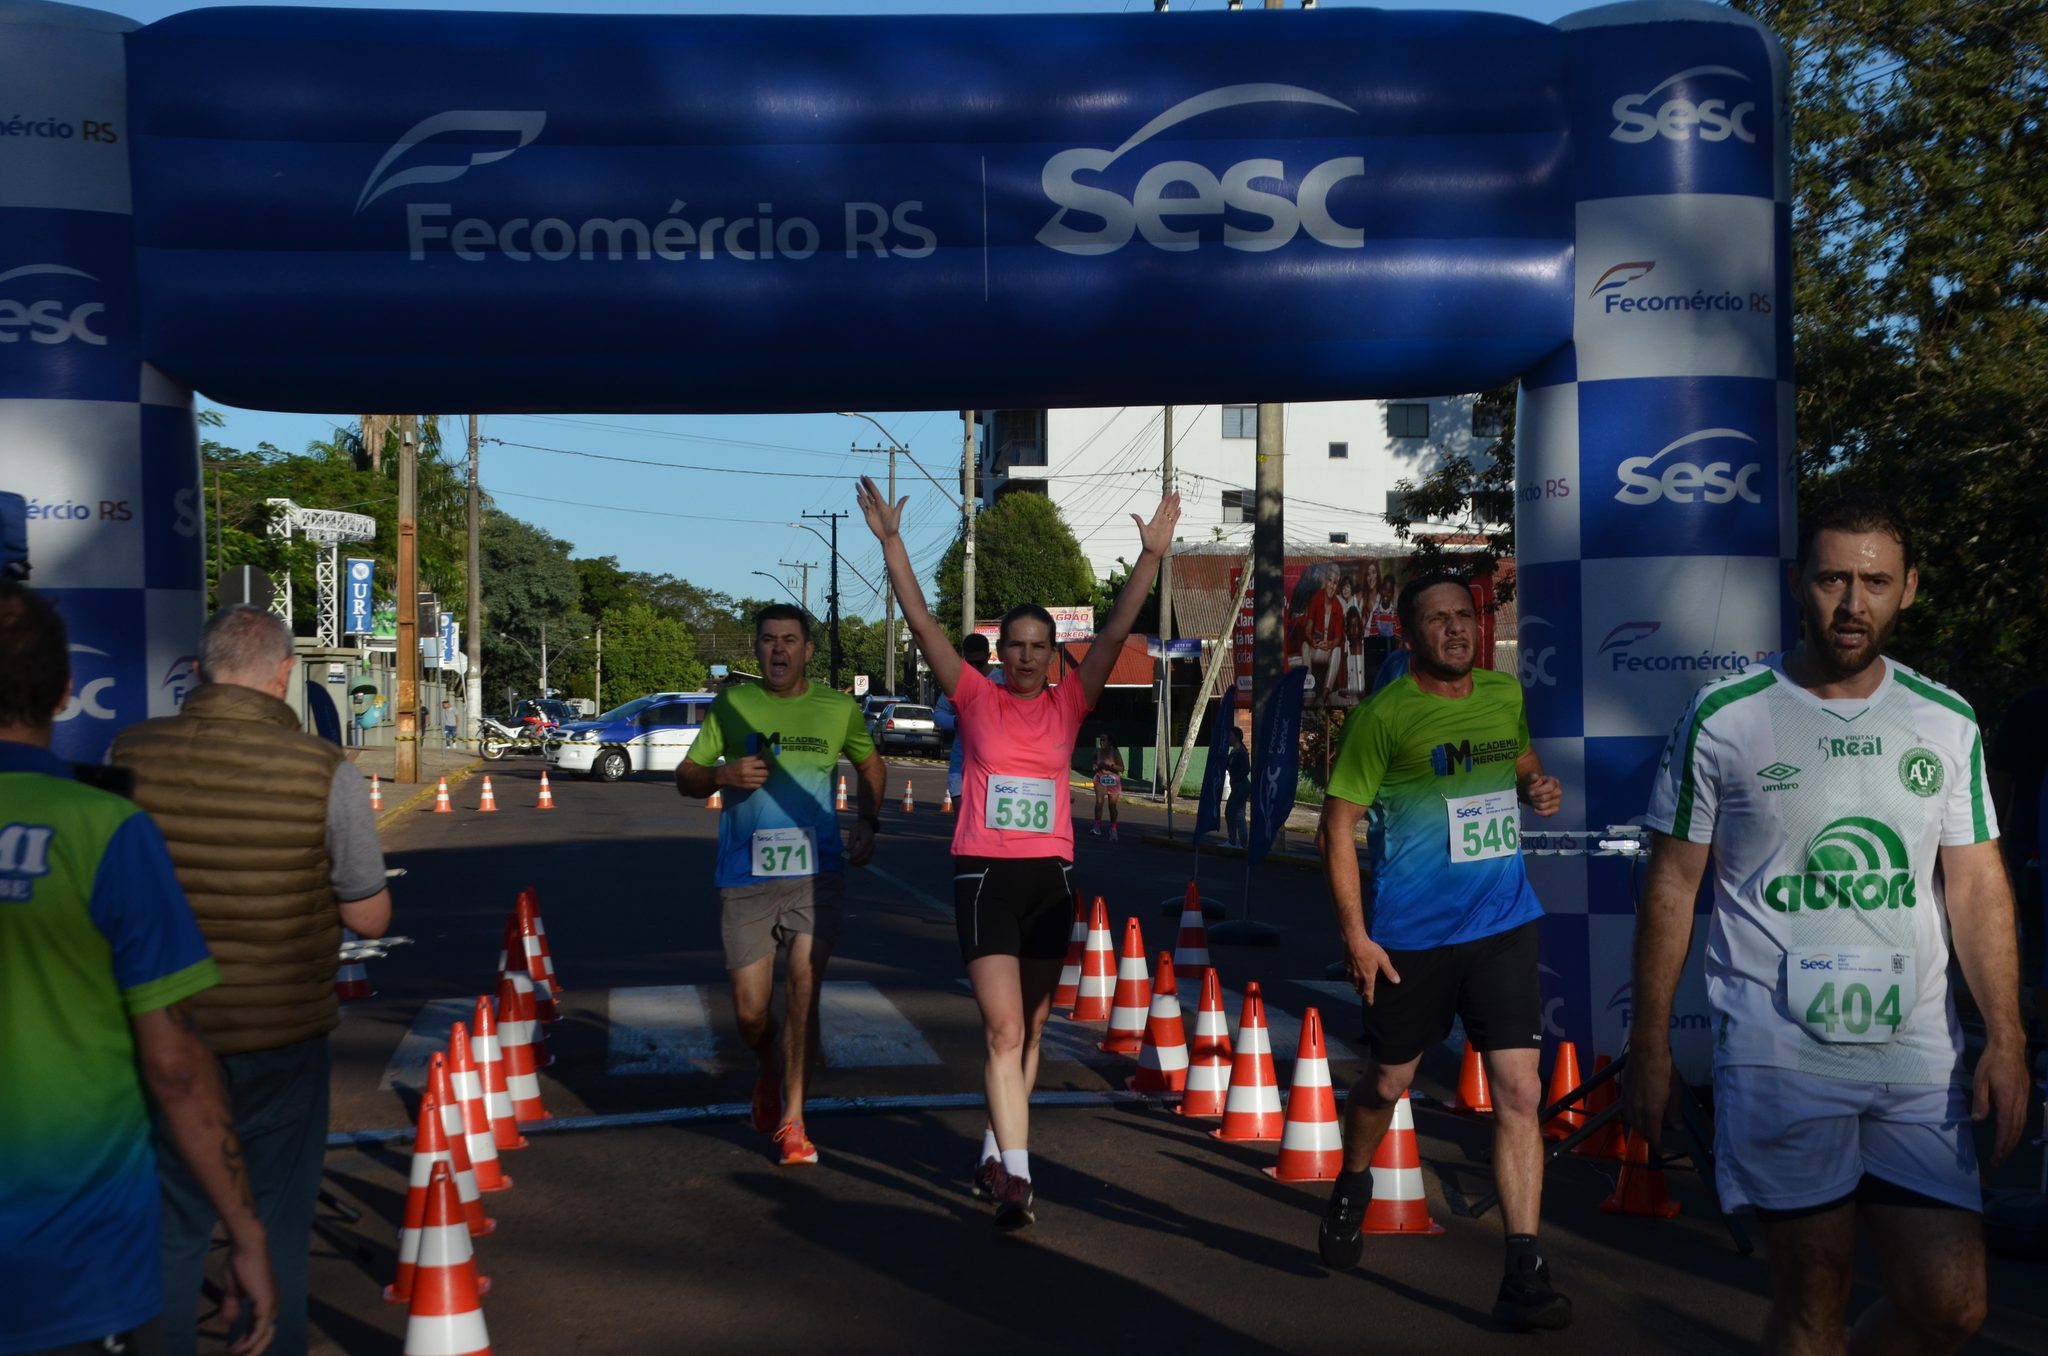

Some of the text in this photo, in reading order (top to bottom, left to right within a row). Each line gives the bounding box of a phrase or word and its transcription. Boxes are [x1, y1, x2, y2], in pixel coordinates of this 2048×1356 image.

[1608, 93, 1757, 144] Sesc
[82, 119, 118, 144] RS
[1034, 147, 1366, 256] Sesc
[406, 198, 939, 262] Fecomércio RS
[1605, 290, 1773, 314] Fecomércio RS
[1545, 478, 1571, 500] RS
[1613, 455, 1762, 506] Sesc
[99, 500, 134, 522] RS
[352, 583, 368, 631] URI
[1612, 650, 1750, 672] Fecomércio
[782, 736, 829, 746] ACADEMIA
[1472, 738, 1519, 754] ACADEMIA
[1830, 737, 1883, 758] Real
[994, 784, 1019, 794] Sesc
[1762, 782, 1800, 792] umbro
[995, 797, 1049, 830] 538
[1456, 806, 1483, 819] Sesc
[1463, 815, 1517, 857] 546
[760, 844, 808, 872] 371
[1800, 959, 1833, 970] Sesc
[1805, 981, 1903, 1035] 404
